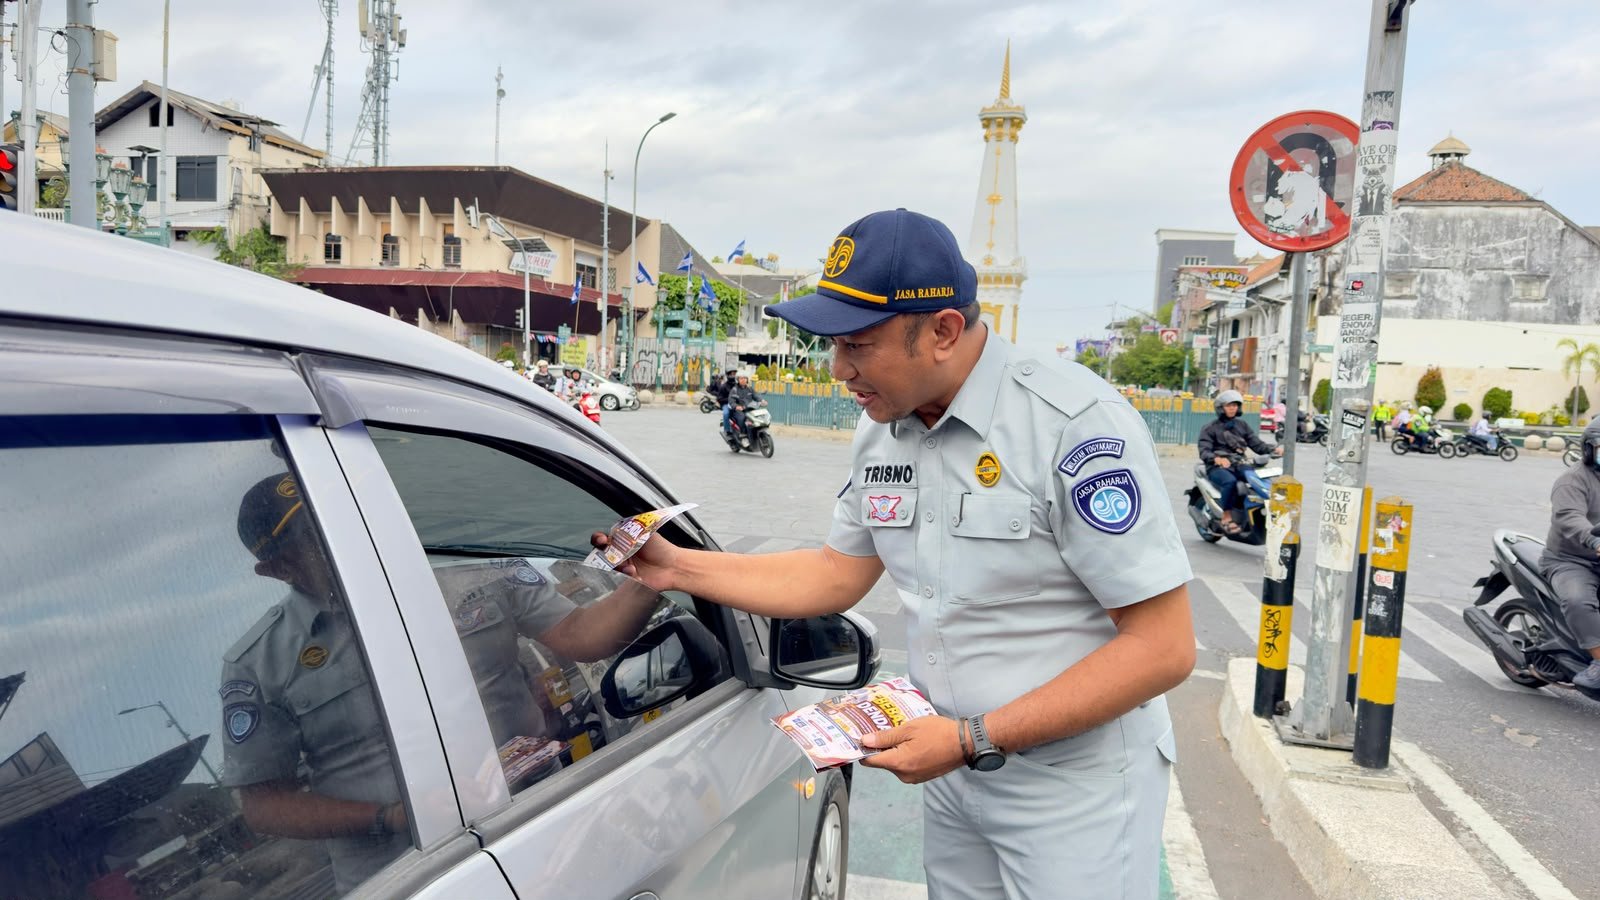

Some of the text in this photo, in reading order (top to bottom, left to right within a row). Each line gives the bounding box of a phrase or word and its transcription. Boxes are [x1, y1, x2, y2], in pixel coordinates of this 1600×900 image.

[895, 287, 954, 300] JASA RAHARJA
[1085, 442, 1120, 455] YOGYAKARTA
[864, 464, 913, 483] TRISNO
[1078, 476, 1129, 499] JASA RAHARJA
[1323, 499, 1348, 513] SIM
